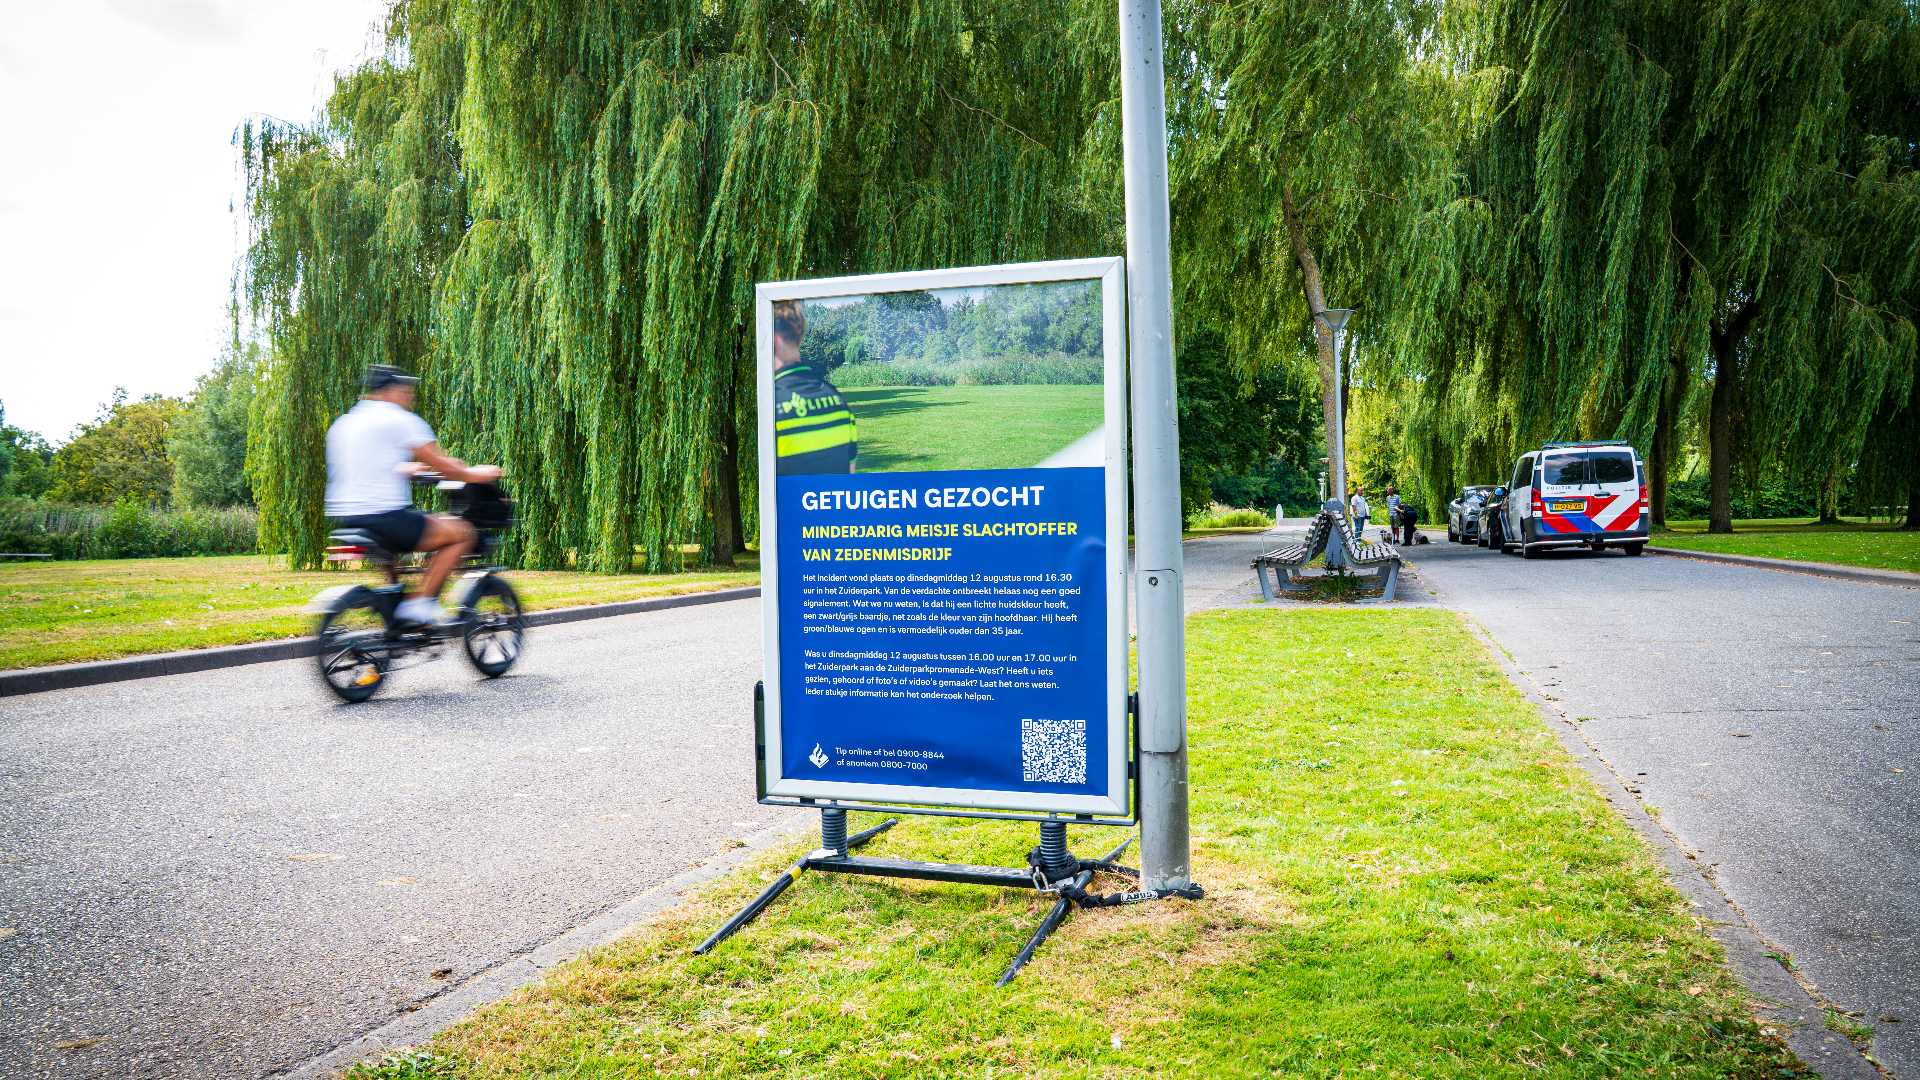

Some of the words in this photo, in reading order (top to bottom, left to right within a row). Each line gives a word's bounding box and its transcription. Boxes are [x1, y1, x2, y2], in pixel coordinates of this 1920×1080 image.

[801, 489, 918, 511] GETUIGEN
[923, 486, 1045, 509] GEZOCHT
[802, 525, 903, 539] MINDERJARIG
[906, 524, 959, 538] MEISJE
[962, 522, 1078, 537] SLACHTOFFER
[802, 549, 831, 562] VAN
[834, 548, 953, 562] ZEDENMISDRIJF
[802, 573, 817, 582] Het
[817, 573, 848, 582] incident
[848, 573, 869, 582] vond
[869, 573, 894, 584] plaats
[895, 575, 906, 584] op
[906, 573, 968, 584] dinsdagmiddag
[970, 573, 982, 582] 12
[983, 574, 1022, 584] augustus
[1023, 573, 1043, 582] rond
[1045, 573, 1073, 582] 16.30
[816, 586, 824, 595] in
[824, 586, 838, 595] het
[838, 586, 883, 597] Zuiderpark.
[883, 586, 899, 595] Van
[900, 586, 911, 595] de
[911, 586, 951, 595] verdachte
[952, 586, 992, 595] ontbreekt
[993, 586, 1021, 595] helaas
[1022, 588, 1039, 597] nog
[1040, 588, 1057, 596] een
[1058, 586, 1081, 597] goed
[803, 598, 851, 609] signalement.
[852, 599, 870, 608] Wat
[894, 600, 921, 609] weten,
[922, 599, 930, 608] is
[930, 599, 944, 608] dat
[945, 599, 956, 610] hij
[956, 601, 972, 609] een
[973, 599, 997, 609] lichte
[998, 599, 1043, 609] huidskleur
[1043, 599, 1069, 610] heeft,
[818, 611, 858, 622] zwart/grijs
[859, 611, 891, 622] baardje,
[892, 613, 906, 621] net
[906, 612, 927, 621] zoals
[928, 612, 939, 621] de
[940, 612, 961, 622] kleur
[978, 613, 993, 624] zijn
[994, 613, 1039, 622] hoofdhaar.
[1041, 613, 1053, 624] Hij
[1055, 613, 1078, 622] heeft
[803, 624, 855, 634] groen/blauwe
[856, 626, 877, 635] ogen
[877, 626, 888, 634] en
[889, 625, 897, 634] is
[897, 625, 948, 636] vermoedelijk
[948, 626, 973, 635] ouder
[974, 626, 990, 635] dan
[991, 626, 1004, 635] 35
[1004, 626, 1024, 637] jaar.
[804, 649, 821, 658] Was
[828, 649, 888, 661] dinsdagmiddag
[890, 651, 901, 659] 12
[902, 652, 939, 662] augustus
[939, 652, 967, 661] tussen
[968, 652, 995, 662] 16.00
[1024, 653, 1051, 663] 17.00
[1052, 655, 1068, 663] uur
[1069, 653, 1077, 662] in
[804, 661, 817, 670] het
[817, 662, 859, 673] Zuiderpark
[875, 663, 887, 672] de
[887, 663, 1005, 676] Zuiderparkpromenade-West?
[1006, 666, 1029, 675] Heeft
[1037, 667, 1054, 676] iets
[805, 675, 831, 685] gezien,
[832, 675, 865, 685] gehoord
[865, 676, 875, 685] of
[899, 676, 908, 685] of
[938, 678, 978, 688] gemaakt?
[979, 679, 998, 688] Laat
[998, 679, 1013, 688] het
[1013, 681, 1030, 689] ons
[1030, 681, 1060, 689] weten.
[805, 686, 825, 696] Ieder
[825, 687, 848, 698] stukje
[849, 688, 889, 698] informatie
[890, 689, 905, 698] kan
[906, 689, 920, 699] het
[920, 690, 963, 700] onderzoek
[964, 691, 995, 702] helpen.
[835, 746, 848, 757] Tip
[848, 747, 873, 756] online
[873, 748, 882, 756] of
[882, 748, 896, 757] bel
[836, 758, 845, 766] of
[846, 759, 880, 768] anoniem
[880, 760, 928, 771] 0800-7000
[1126, 892, 1153, 900] ABUS
